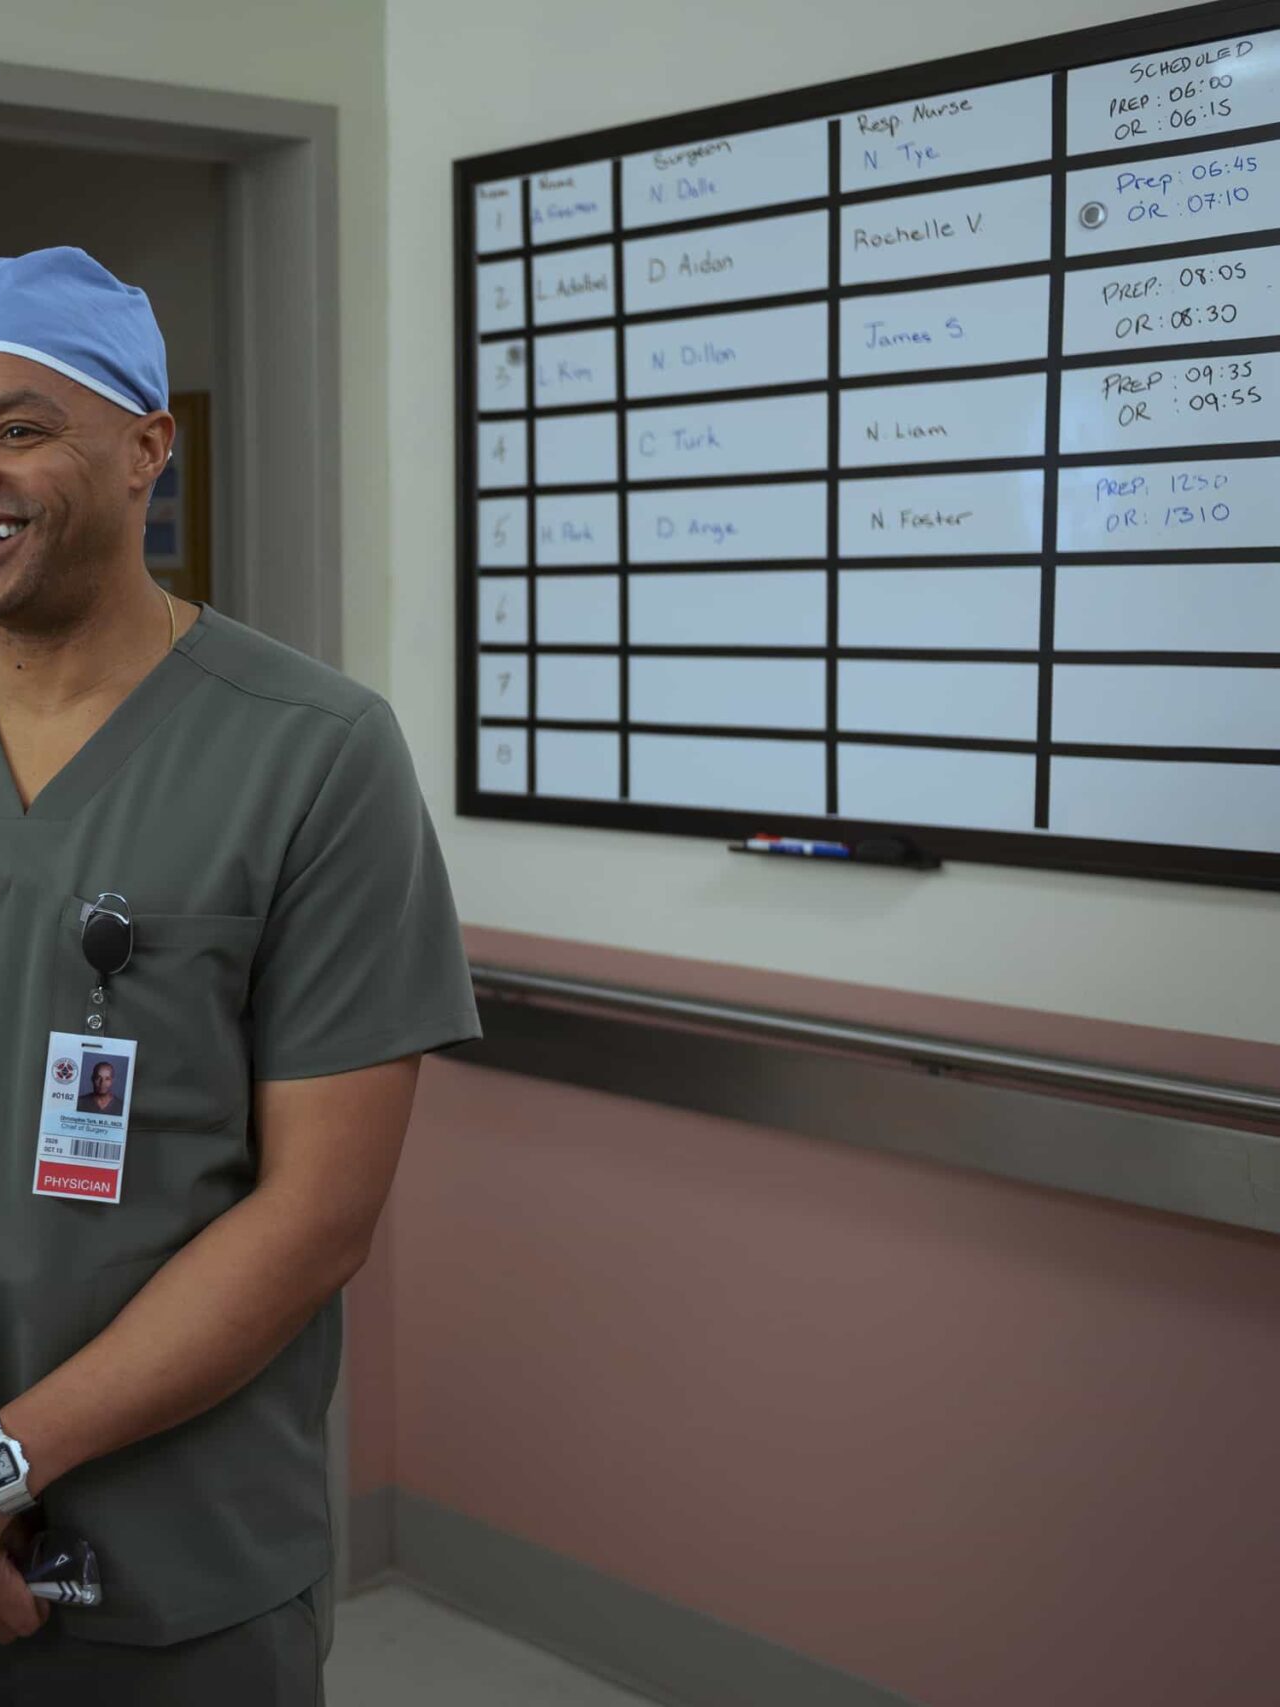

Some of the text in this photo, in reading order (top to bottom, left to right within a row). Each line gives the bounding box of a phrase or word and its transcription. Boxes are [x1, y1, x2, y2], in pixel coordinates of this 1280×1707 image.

[1130, 40, 1254, 83] SCHEDULED
[1169, 74, 1233, 102] 06:00
[912, 99, 973, 124] Nurse
[1170, 98, 1232, 128] 06:15
[653, 140, 732, 171] Surgeon
[864, 142, 941, 170] N Tye
[1191, 155, 1258, 180] 06:45
[649, 182, 663, 203] N
[1187, 187, 1250, 213] 07:10
[854, 218, 956, 251] Rochelle
[647, 257, 666, 284] D
[1179, 262, 1247, 287] 08:05
[495, 286, 510, 310] 2
[1171, 303, 1238, 329] 08:30
[864, 321, 933, 350] James
[652, 352, 665, 371] N
[1185, 361, 1253, 386] 09:35
[1189, 386, 1262, 412] 09:55
[639, 425, 721, 457] C Turk
[895, 421, 948, 440] Liam
[493, 436, 506, 464] 4
[1164, 503, 1231, 526] 1310
[494, 512, 511, 548] 5
[656, 516, 674, 541] D
[495, 594, 507, 624] 6
[497, 671, 511, 696] 7
[496, 743, 512, 766] 8
[43, 1174, 111, 1193] PHYSICIAN
